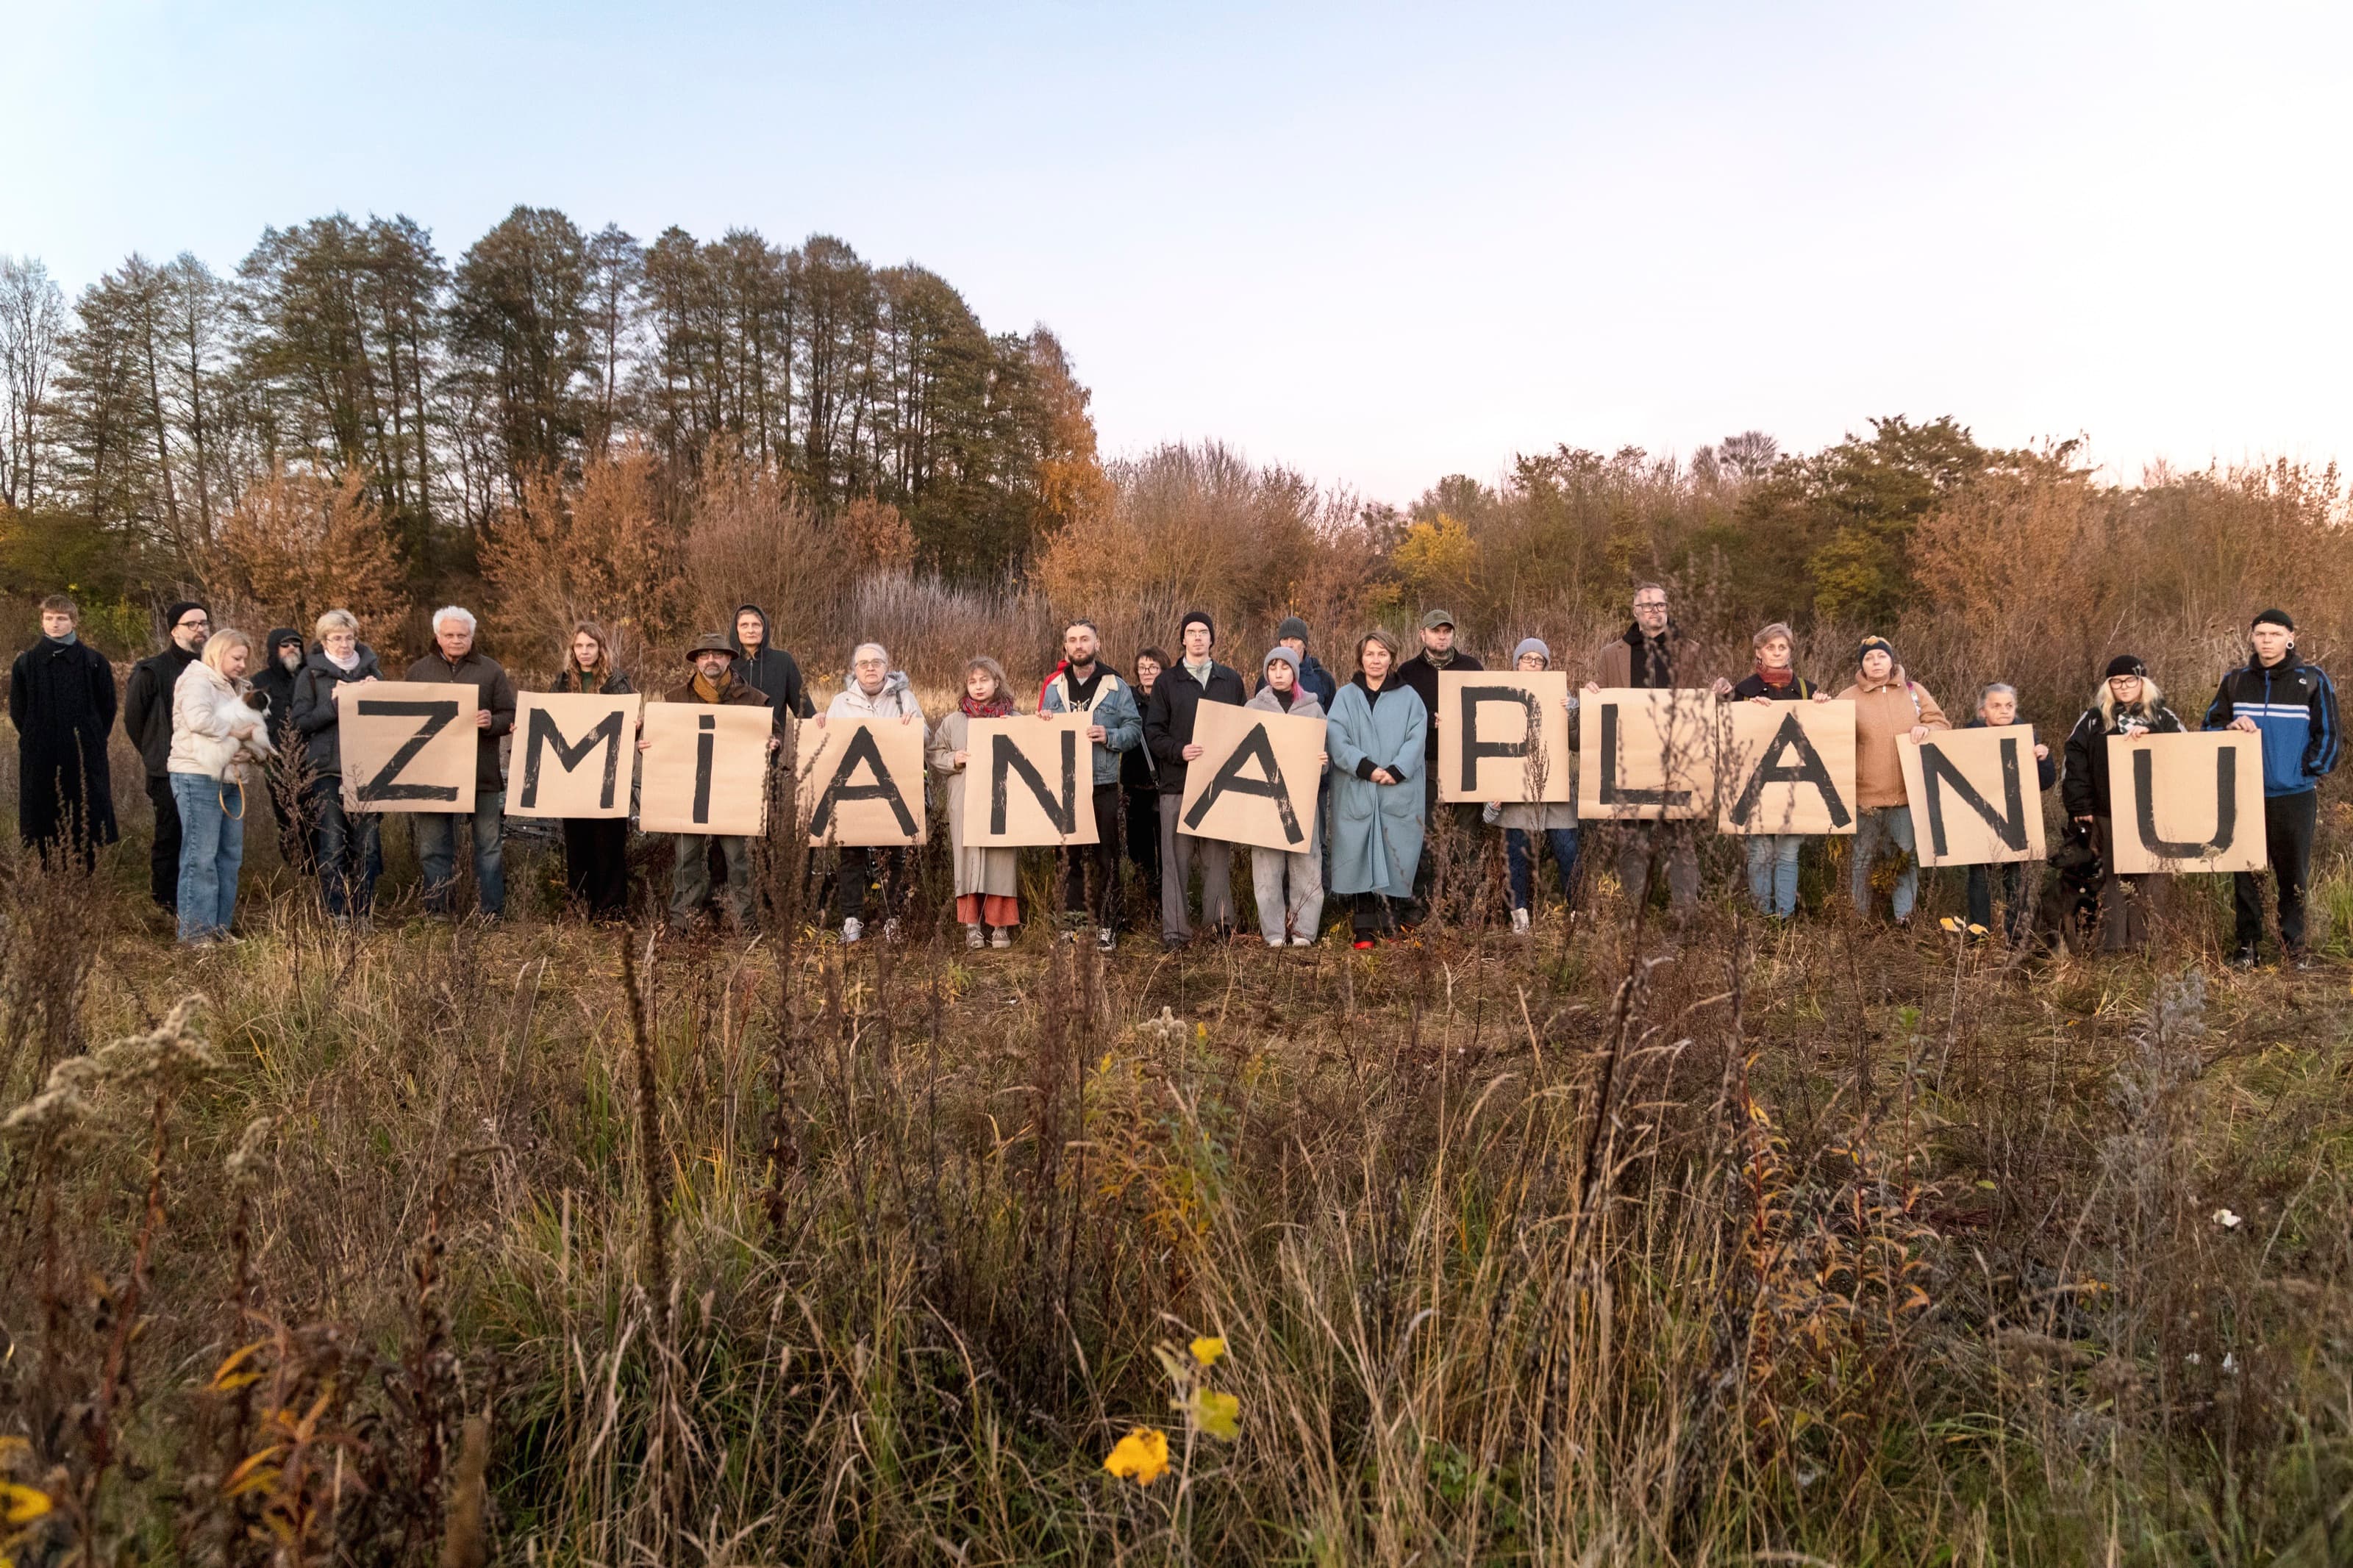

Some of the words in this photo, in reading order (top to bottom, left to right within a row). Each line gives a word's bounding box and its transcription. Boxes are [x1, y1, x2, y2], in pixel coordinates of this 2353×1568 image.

[357, 700, 458, 801] Z
[521, 708, 624, 809] M
[810, 726, 919, 837] A
[990, 731, 1076, 834] N
[1184, 723, 1304, 845] A
[1461, 686, 1541, 792] P
[1600, 704, 1692, 805] L
[1730, 712, 1852, 828] A
[1920, 738, 2027, 856] N
[2133, 746, 2236, 859] U
